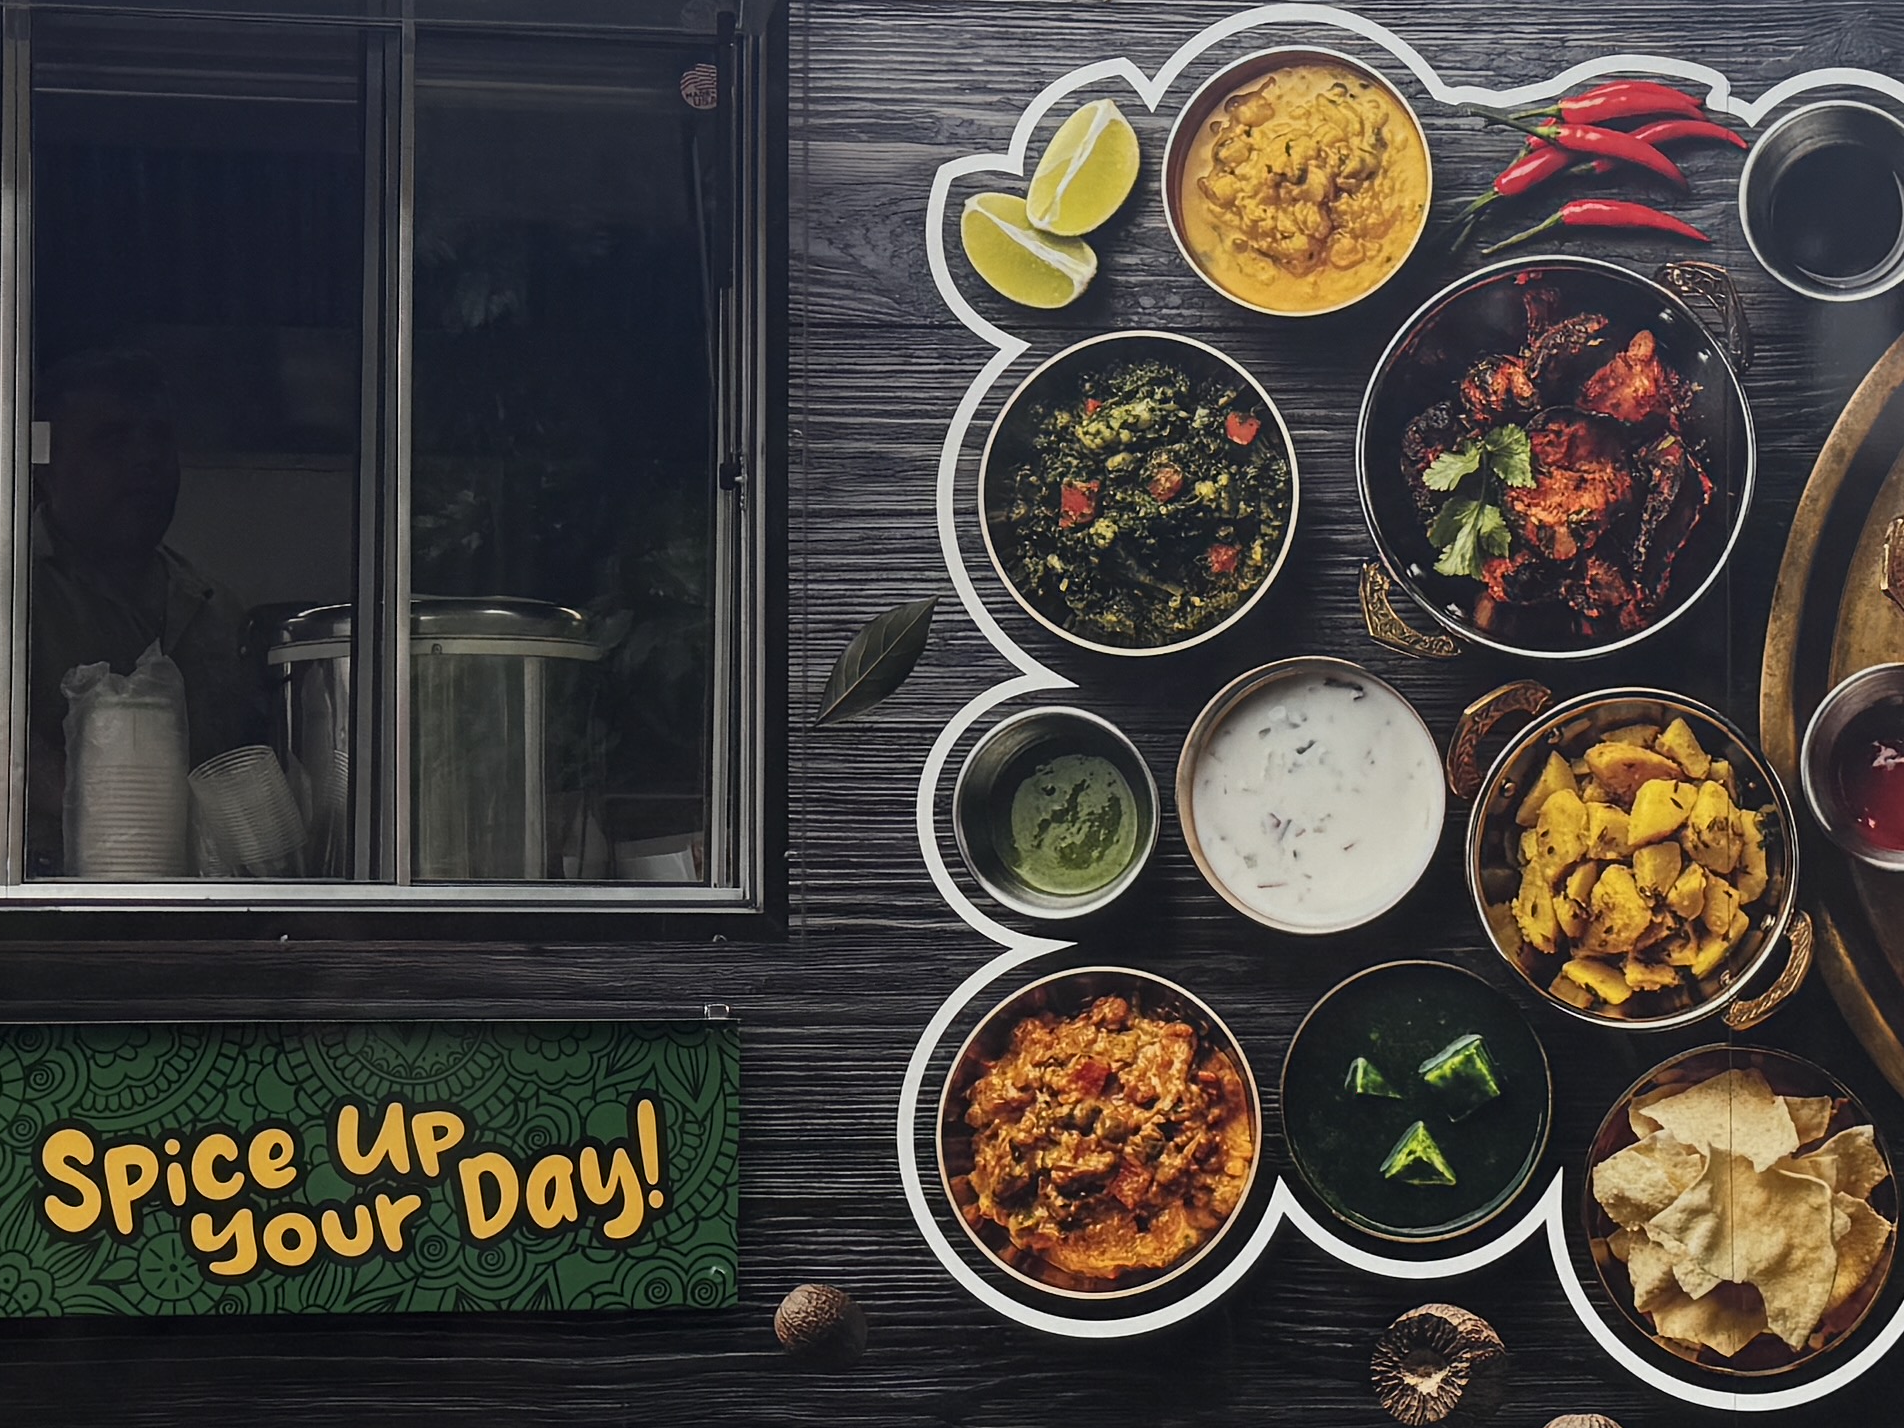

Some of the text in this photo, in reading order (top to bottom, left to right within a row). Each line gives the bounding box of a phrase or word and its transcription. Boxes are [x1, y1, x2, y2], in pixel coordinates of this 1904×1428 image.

[43, 1130, 297, 1234] Spice
[192, 1099, 666, 1276] your Day!
